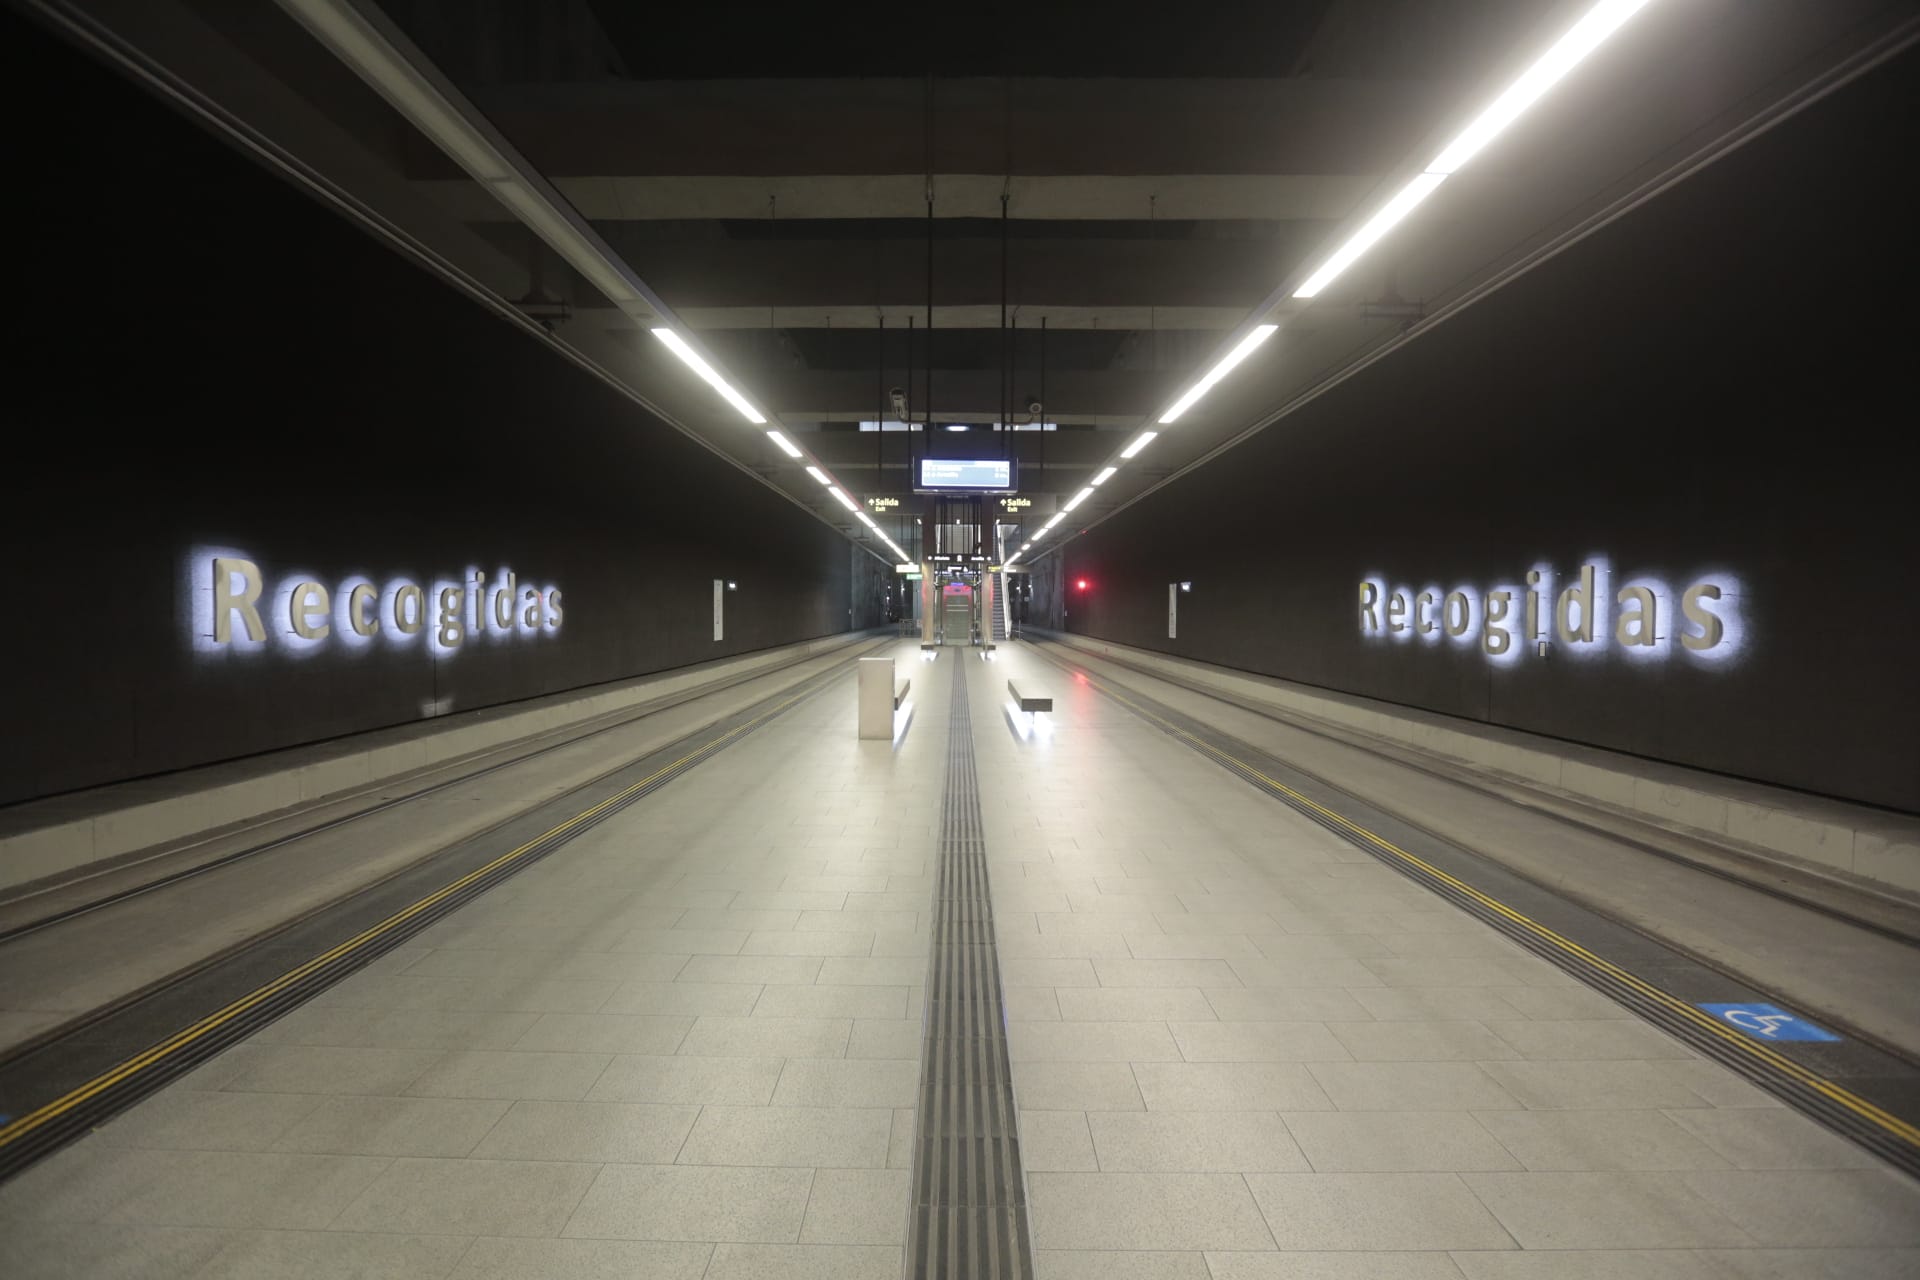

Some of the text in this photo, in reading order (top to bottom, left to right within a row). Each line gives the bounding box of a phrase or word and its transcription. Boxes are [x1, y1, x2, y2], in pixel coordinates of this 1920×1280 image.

[875, 497, 899, 506] Salida
[1007, 497, 1031, 506] Salida
[212, 557, 563, 648] Recogidas
[1358, 564, 1724, 656] Recogidas
